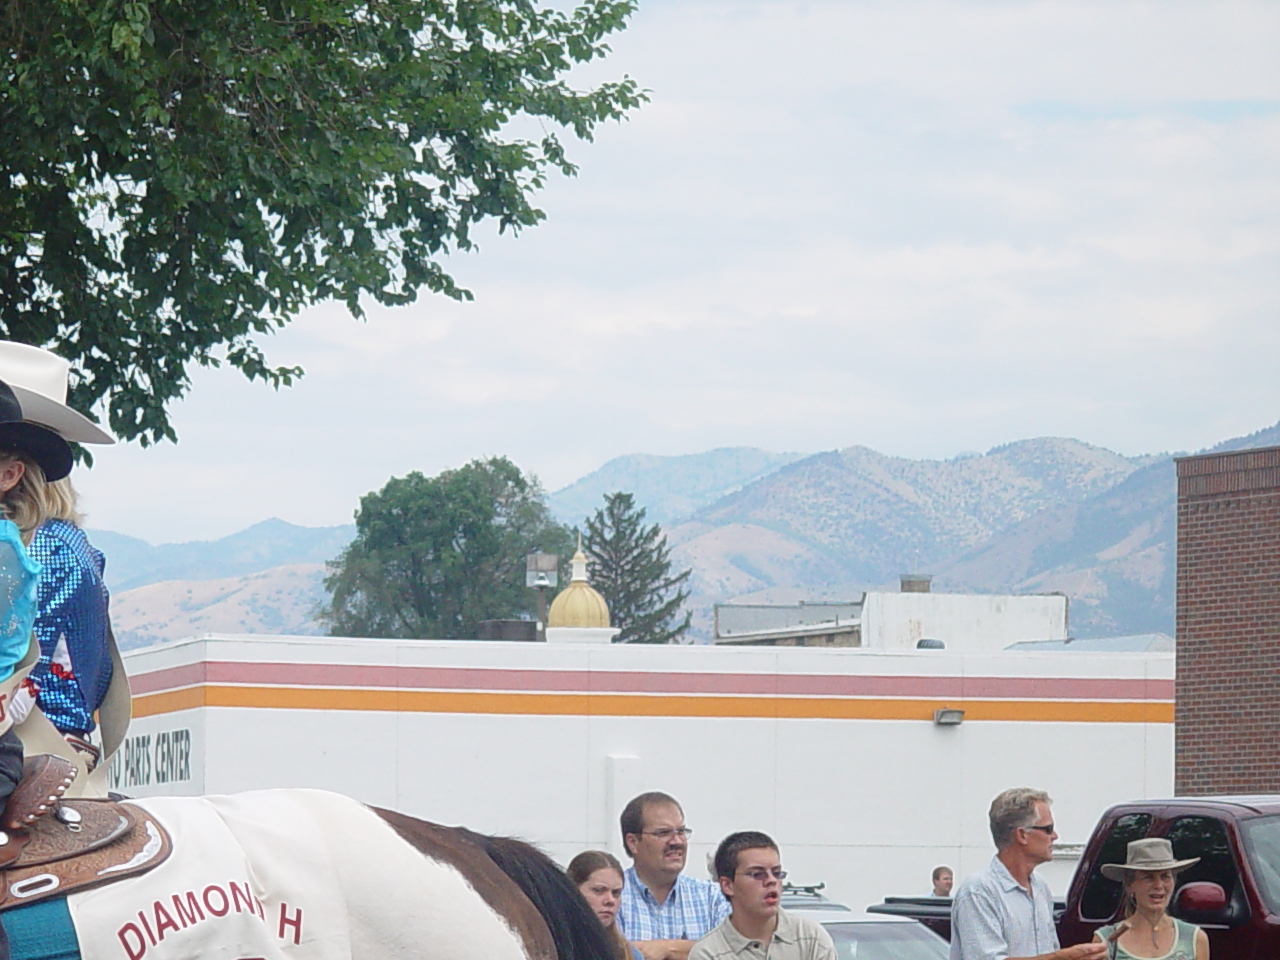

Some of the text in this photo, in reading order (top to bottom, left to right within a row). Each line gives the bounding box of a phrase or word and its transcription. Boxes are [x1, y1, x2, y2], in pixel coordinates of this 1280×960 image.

[124, 734, 151, 788] PARTS
[155, 729, 191, 784] CENTER
[278, 902, 303, 945] H
